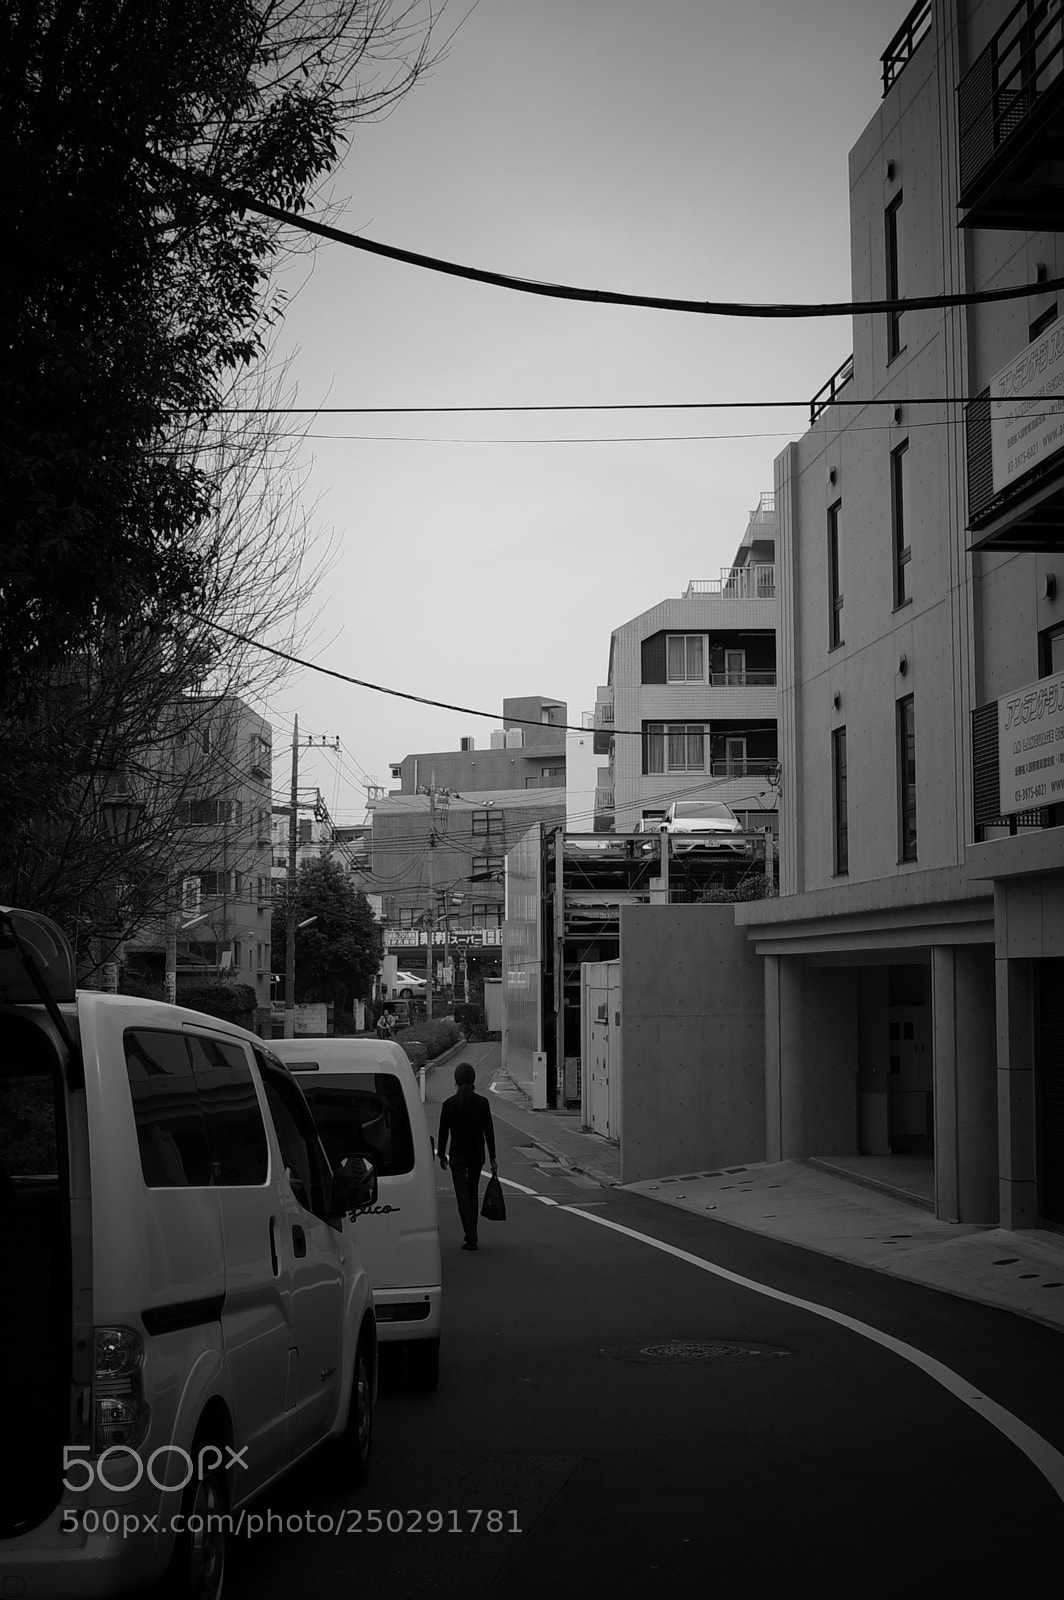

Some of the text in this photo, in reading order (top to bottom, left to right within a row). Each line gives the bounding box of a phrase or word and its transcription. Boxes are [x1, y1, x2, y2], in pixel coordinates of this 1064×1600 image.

[1008, 442, 1038, 474] 03-3975-6021
[1023, 730, 1055, 751] LANGUAGE
[1015, 783, 1047, 802] 03-3975-6021
